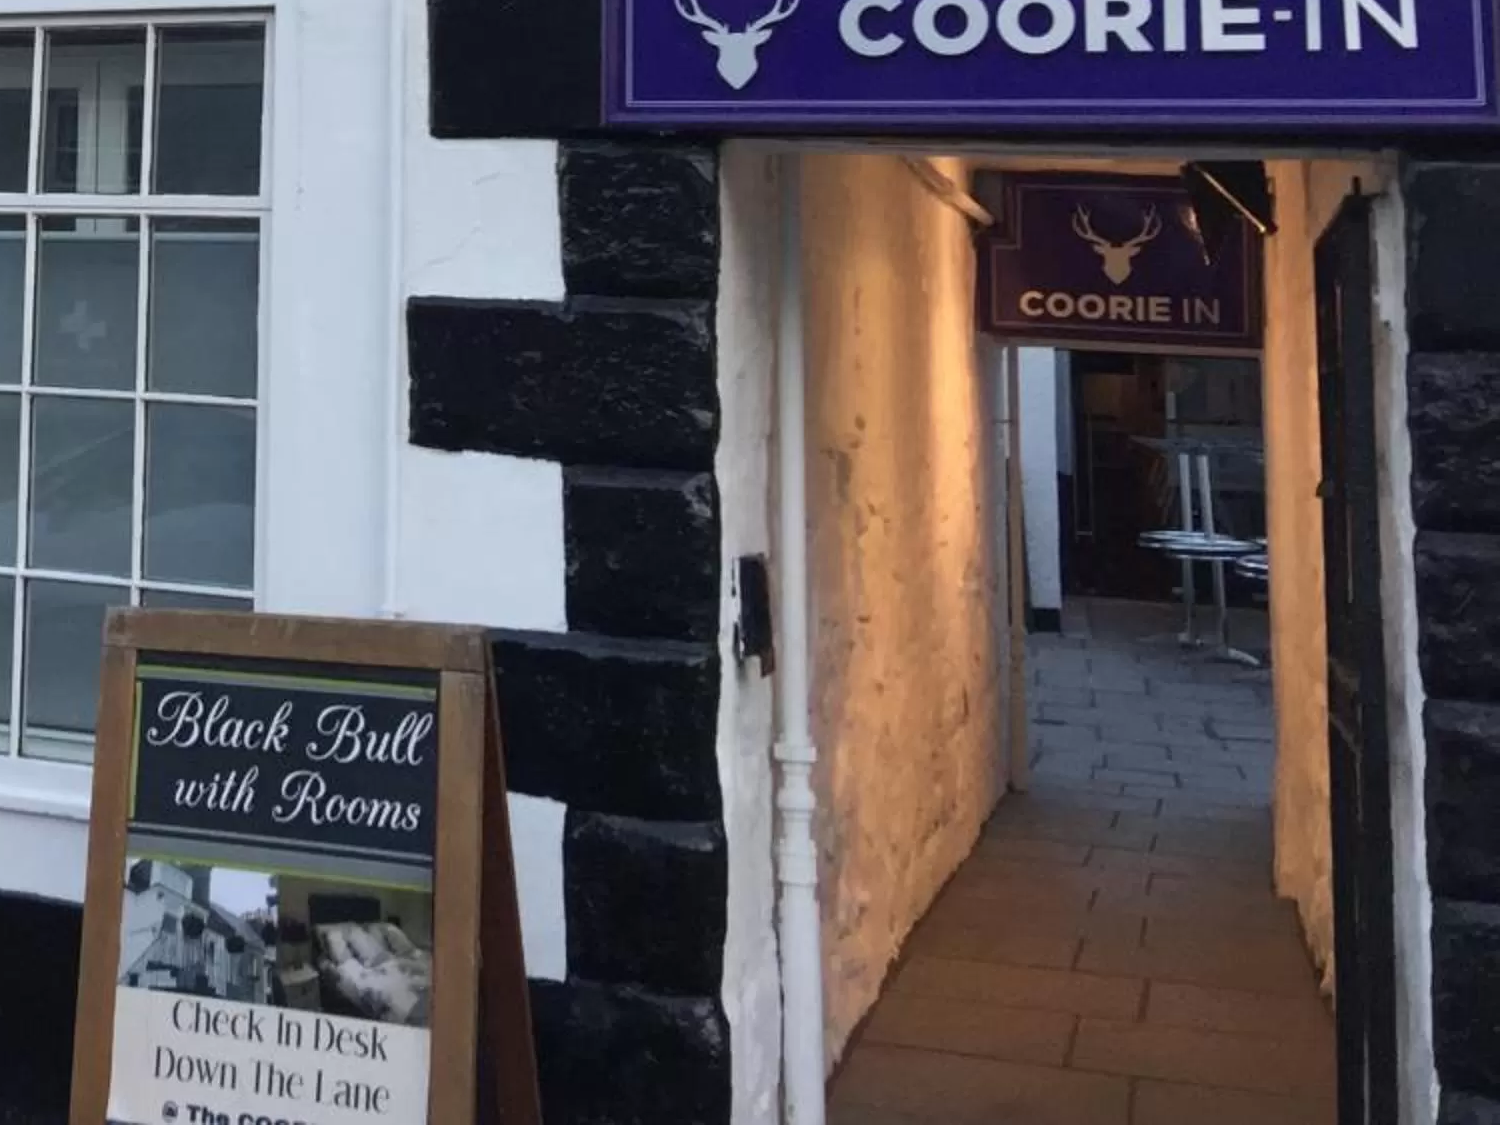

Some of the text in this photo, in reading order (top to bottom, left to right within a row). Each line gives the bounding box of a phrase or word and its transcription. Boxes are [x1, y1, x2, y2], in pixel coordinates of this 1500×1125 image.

[1019, 290, 1221, 324] COORIE IN
[146, 689, 434, 765] Black Bull
[174, 765, 422, 832] with Rooms
[172, 998, 389, 1063] Check In Desk
[154, 1045, 391, 1115] Down The Lane
